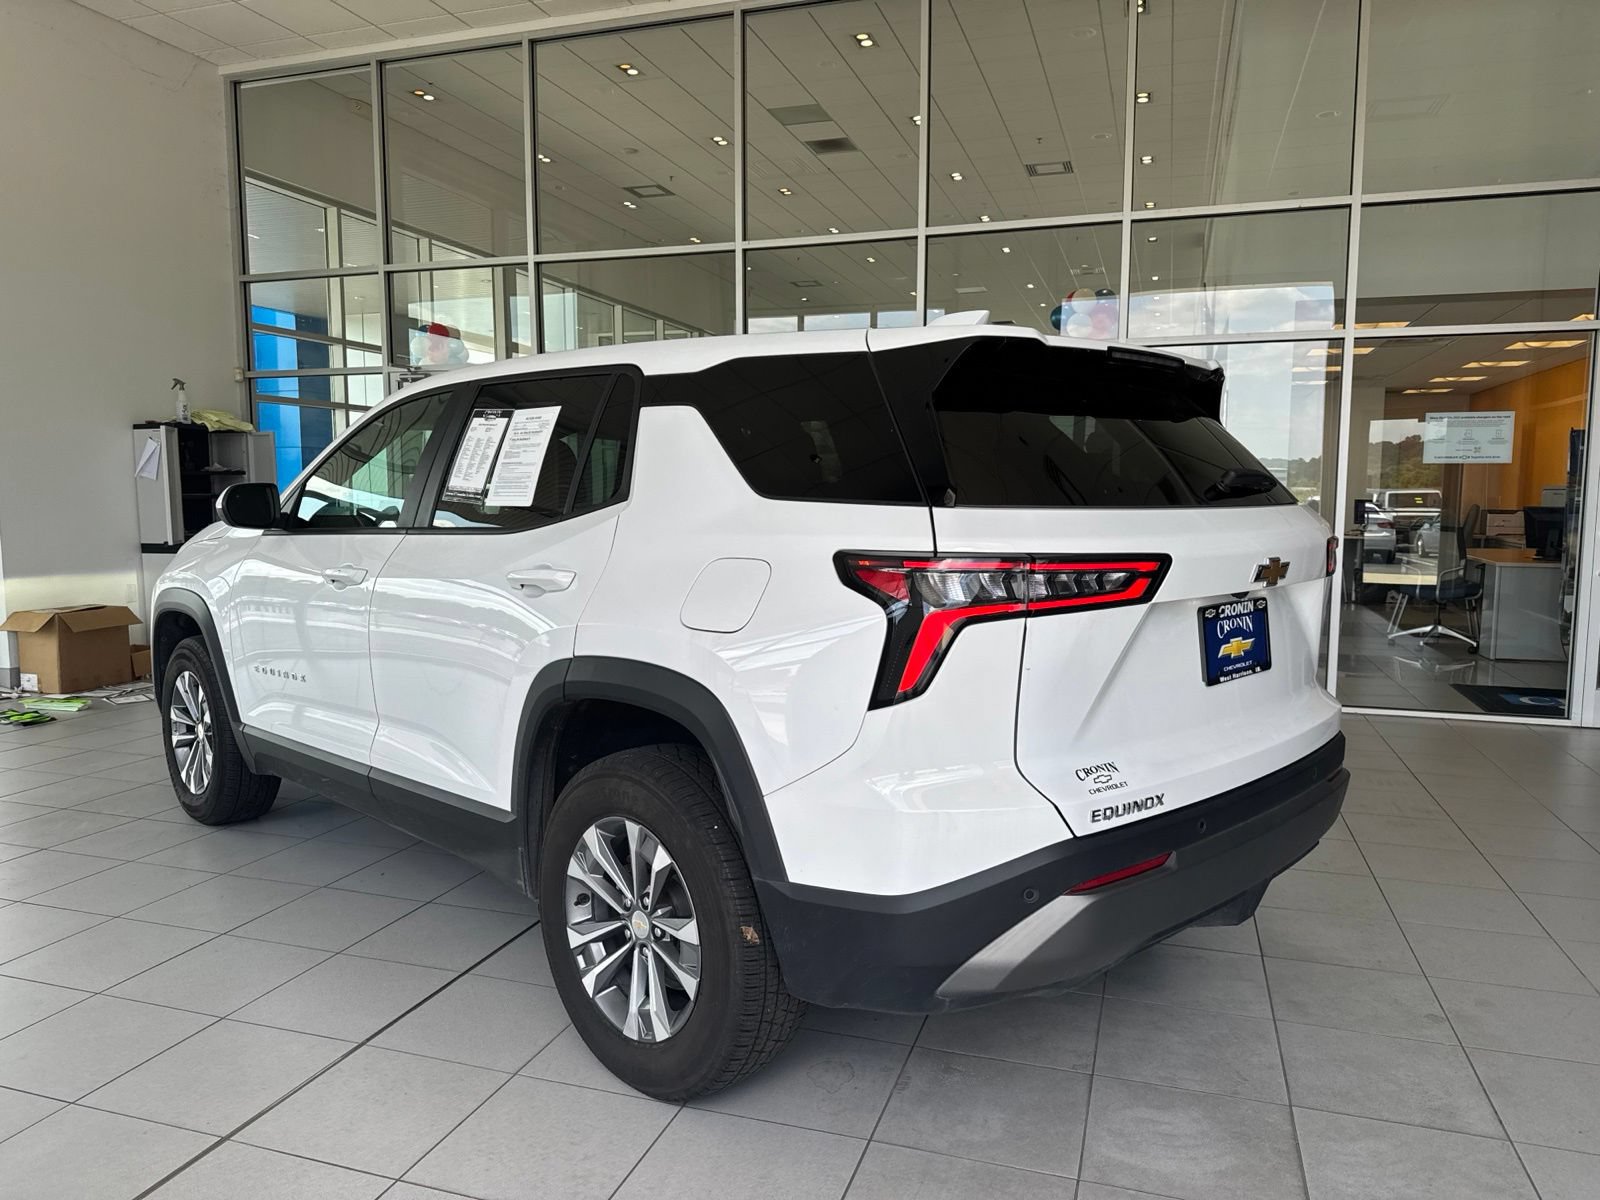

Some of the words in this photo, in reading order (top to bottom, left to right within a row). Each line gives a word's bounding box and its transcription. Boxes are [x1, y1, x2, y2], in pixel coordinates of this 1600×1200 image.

[1218, 600, 1253, 618] CRONIN
[1217, 615, 1253, 639] CRONIN
[1223, 660, 1252, 671] CHEVROLET
[1075, 761, 1120, 782] CRONIN
[1088, 781, 1129, 795] CHEVROLET
[1090, 793, 1165, 823] EQUINOX
